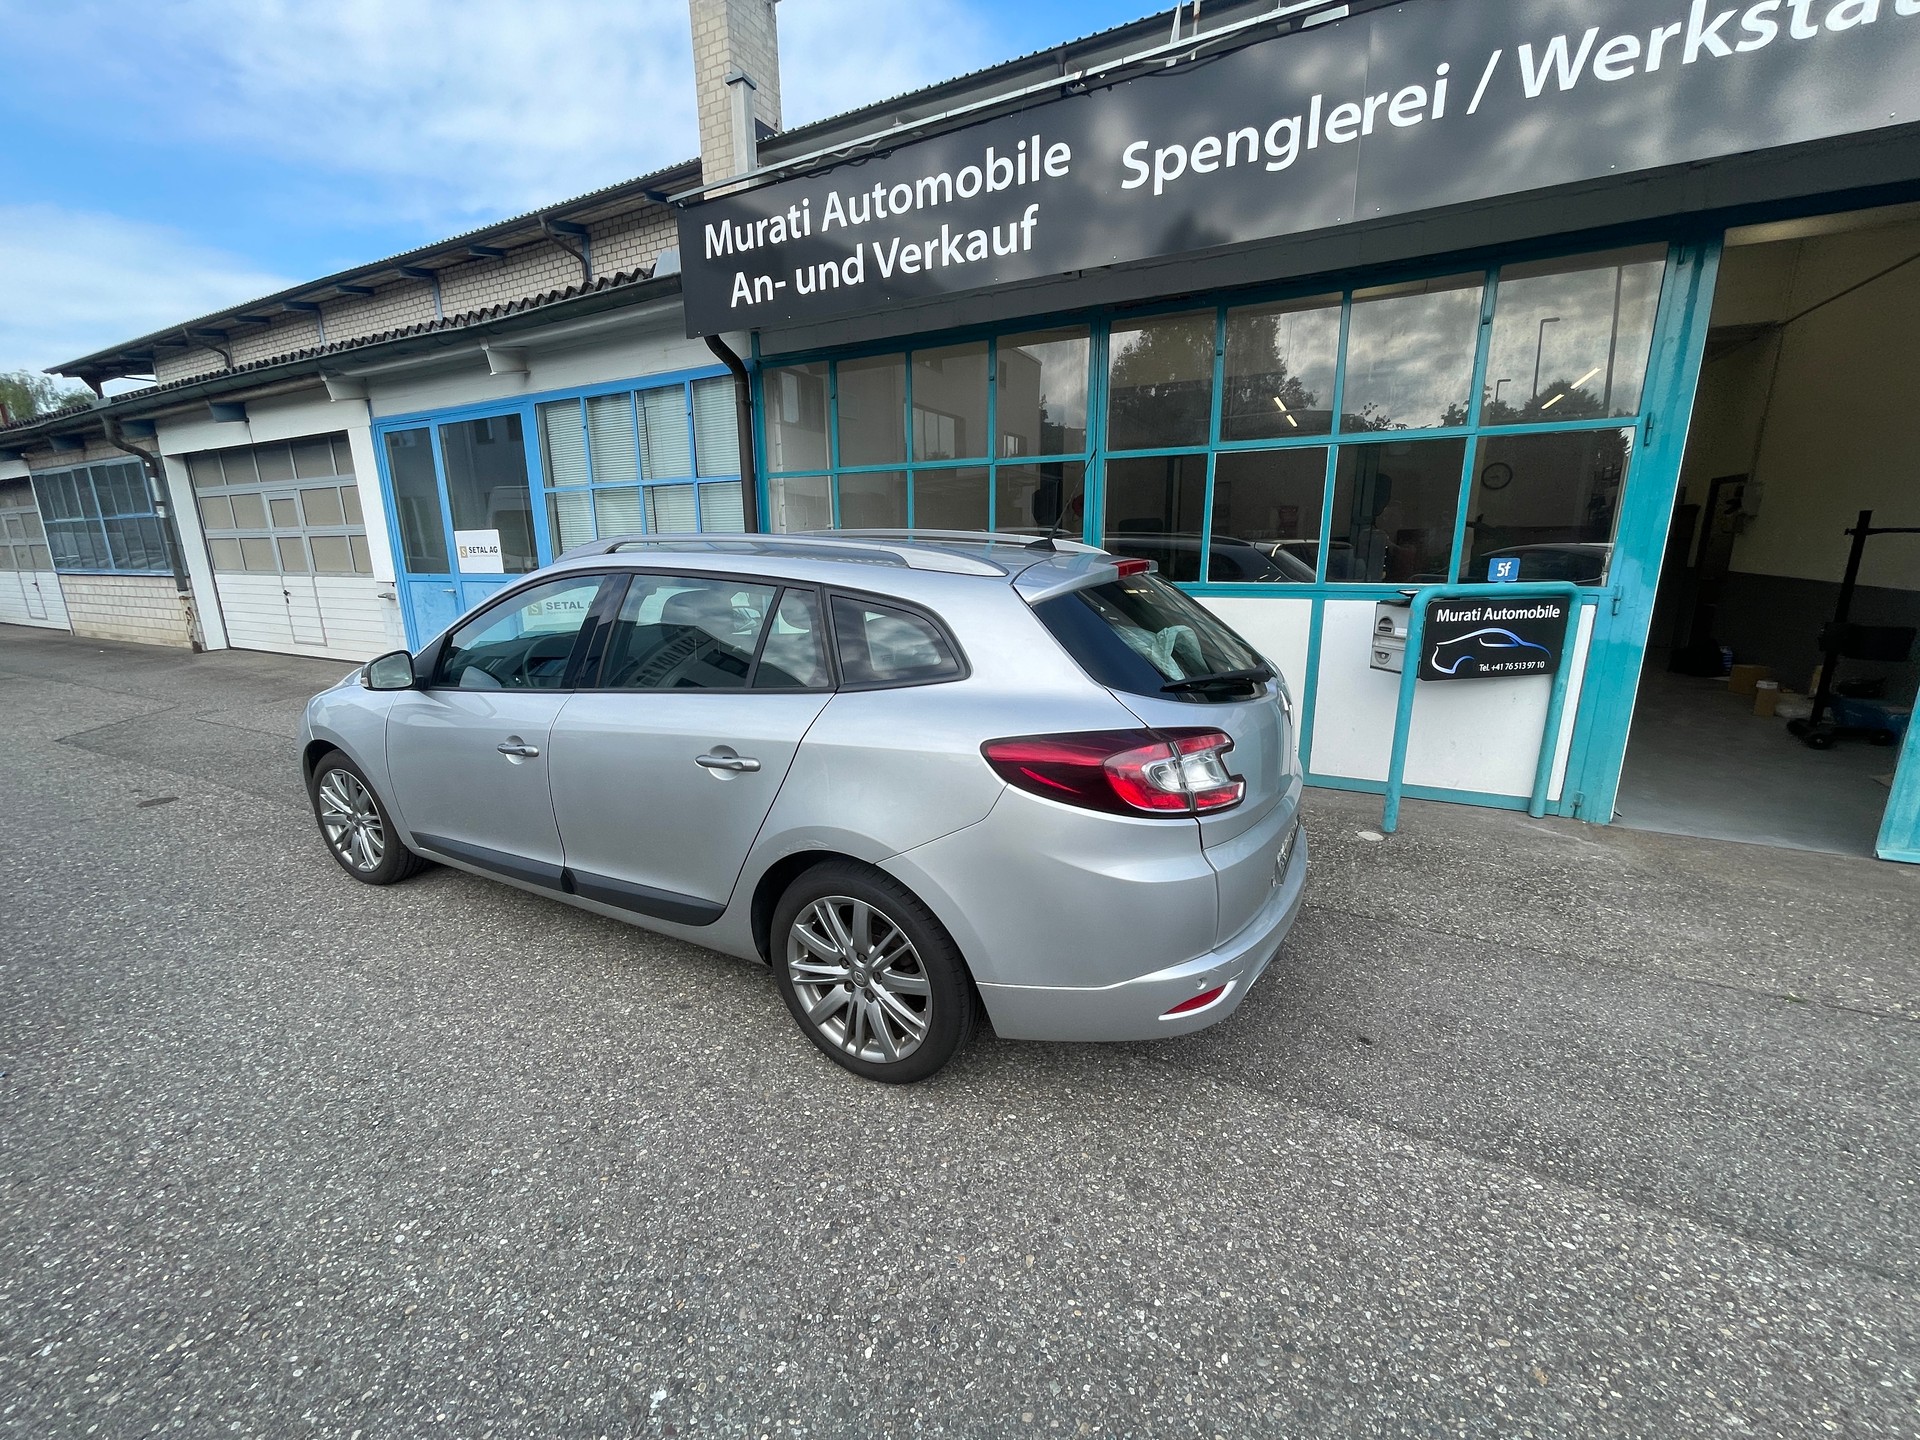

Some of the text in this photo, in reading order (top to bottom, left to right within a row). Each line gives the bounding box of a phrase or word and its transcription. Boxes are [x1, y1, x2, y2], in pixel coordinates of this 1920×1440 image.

[1121, 0, 1920, 197] Spenglerei / Werksta
[704, 134, 1072, 260] Murati Automobile
[730, 203, 1040, 308] An- und Verkauf
[468, 546, 489, 554] SETAL
[489, 545, 499, 554] AG
[1497, 561, 1511, 577] 5f
[545, 601, 585, 611] SETAL
[1436, 604, 1561, 622] Murati Automobile
[1491, 663, 1504, 671] +41
[1504, 662, 1514, 670] 76
[1514, 661, 1527, 670] 513
[1527, 661, 1536, 670] 97
[1537, 660, 1545, 669] 10
